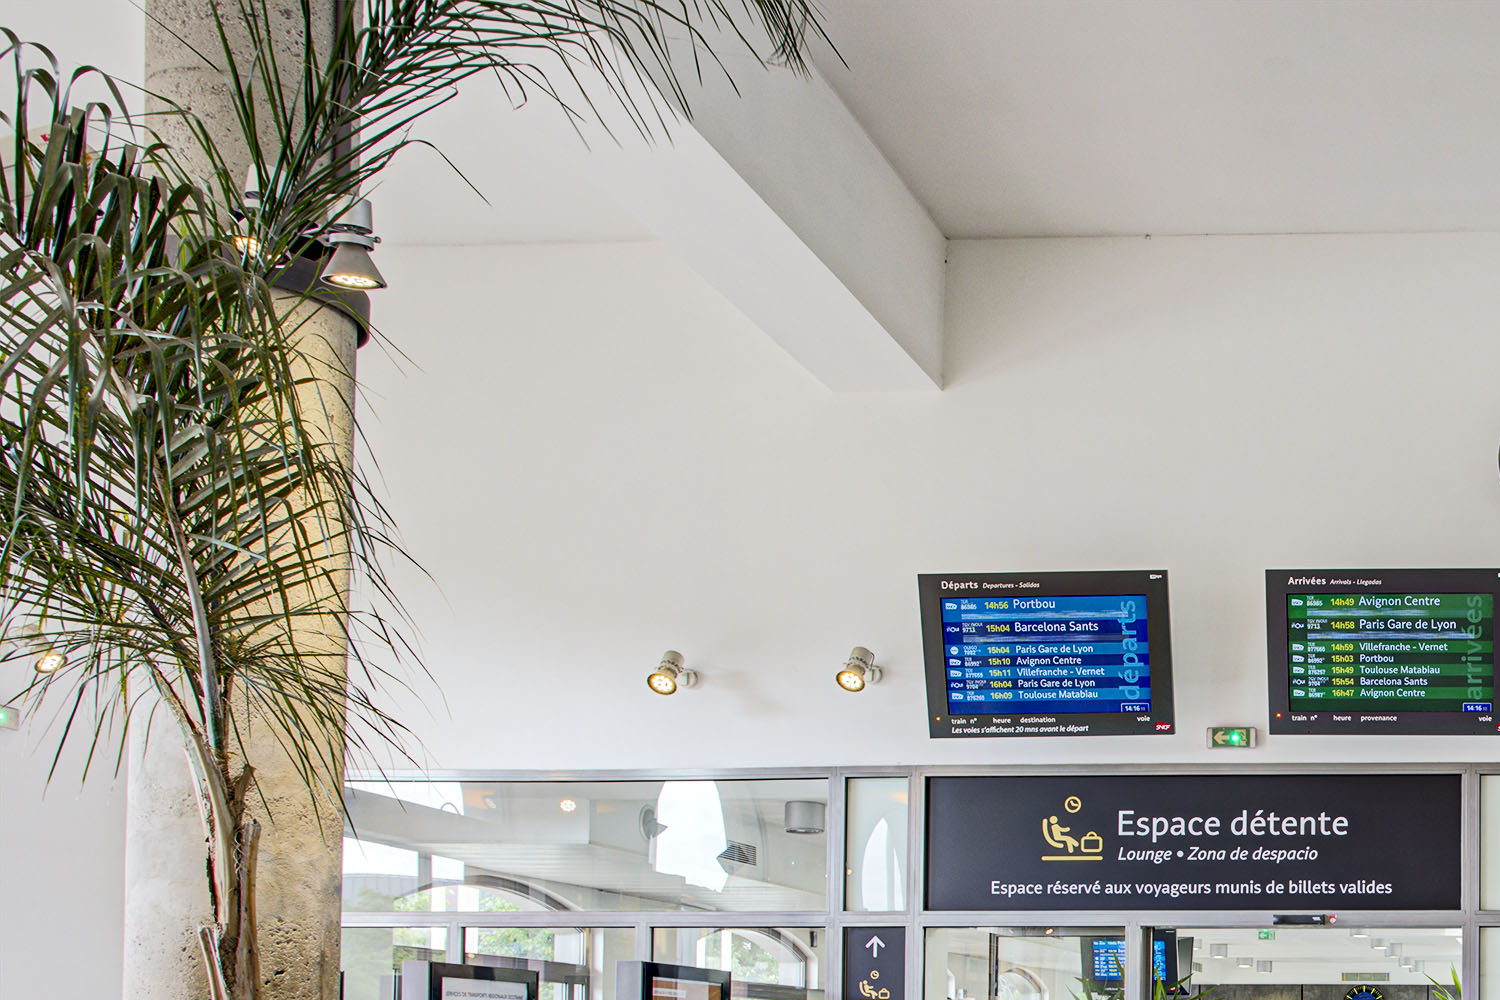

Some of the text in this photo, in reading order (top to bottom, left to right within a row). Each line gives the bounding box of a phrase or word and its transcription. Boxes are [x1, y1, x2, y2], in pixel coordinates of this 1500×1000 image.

[1288, 576, 1326, 585] Arrivées
[940, 581, 978, 591] Départs
[982, 582, 1014, 590] Departures
[1013, 599, 1055, 609] Portbou
[1330, 598, 1354, 606] 14h49
[1359, 596, 1402, 608] Avignon
[1404, 596, 1440, 606] Centre
[986, 624, 1010, 632] 15h04
[1014, 622, 1066, 632] Barcelona
[1069, 622, 1099, 632] Sants
[1360, 619, 1384, 629] Paris
[1387, 620, 1412, 629] Gare
[1416, 620, 1428, 629] de
[1431, 620, 1457, 632] Lyon
[988, 646, 1010, 654] 15h04
[1016, 645, 1036, 654] Paris
[1038, 645, 1058, 653] Gare
[1060, 645, 1070, 653] de
[1073, 644, 1094, 655] Lyon
[1117, 600, 1144, 700] départs
[1359, 642, 1410, 651] Villefranche
[1418, 642, 1448, 651] Vernet
[1461, 595, 1482, 700] arrivées
[1016, 657, 1051, 666] Avignon
[1052, 656, 1082, 665] Centre
[1360, 654, 1394, 662] Portbou
[1016, 668, 1068, 677] Villefranche
[1075, 668, 1105, 676] Vernet
[1331, 666, 1354, 674] 15h49
[1360, 666, 1398, 674] Toulouse
[1400, 666, 1440, 674] Matabiau
[1018, 680, 1038, 688] Paris
[1040, 679, 1060, 688] Gare
[1062, 679, 1072, 687] de
[1074, 679, 1096, 688] Lyon
[1360, 677, 1402, 685] Barcelona
[1404, 677, 1428, 686] Sants
[1018, 691, 1056, 699] Toulouse
[1059, 690, 1098, 698] Matabiau
[1360, 689, 1394, 698] Avignon
[1396, 689, 1426, 697] Centre
[1020, 716, 1056, 724] destination
[1067, 725, 1089, 733] départ
[1118, 808, 1349, 842] Espace détente
[1118, 845, 1318, 864] Lounge Zona de despacio
[991, 879, 1392, 898] Espace réservé aux voyageurs munis de billets valides
